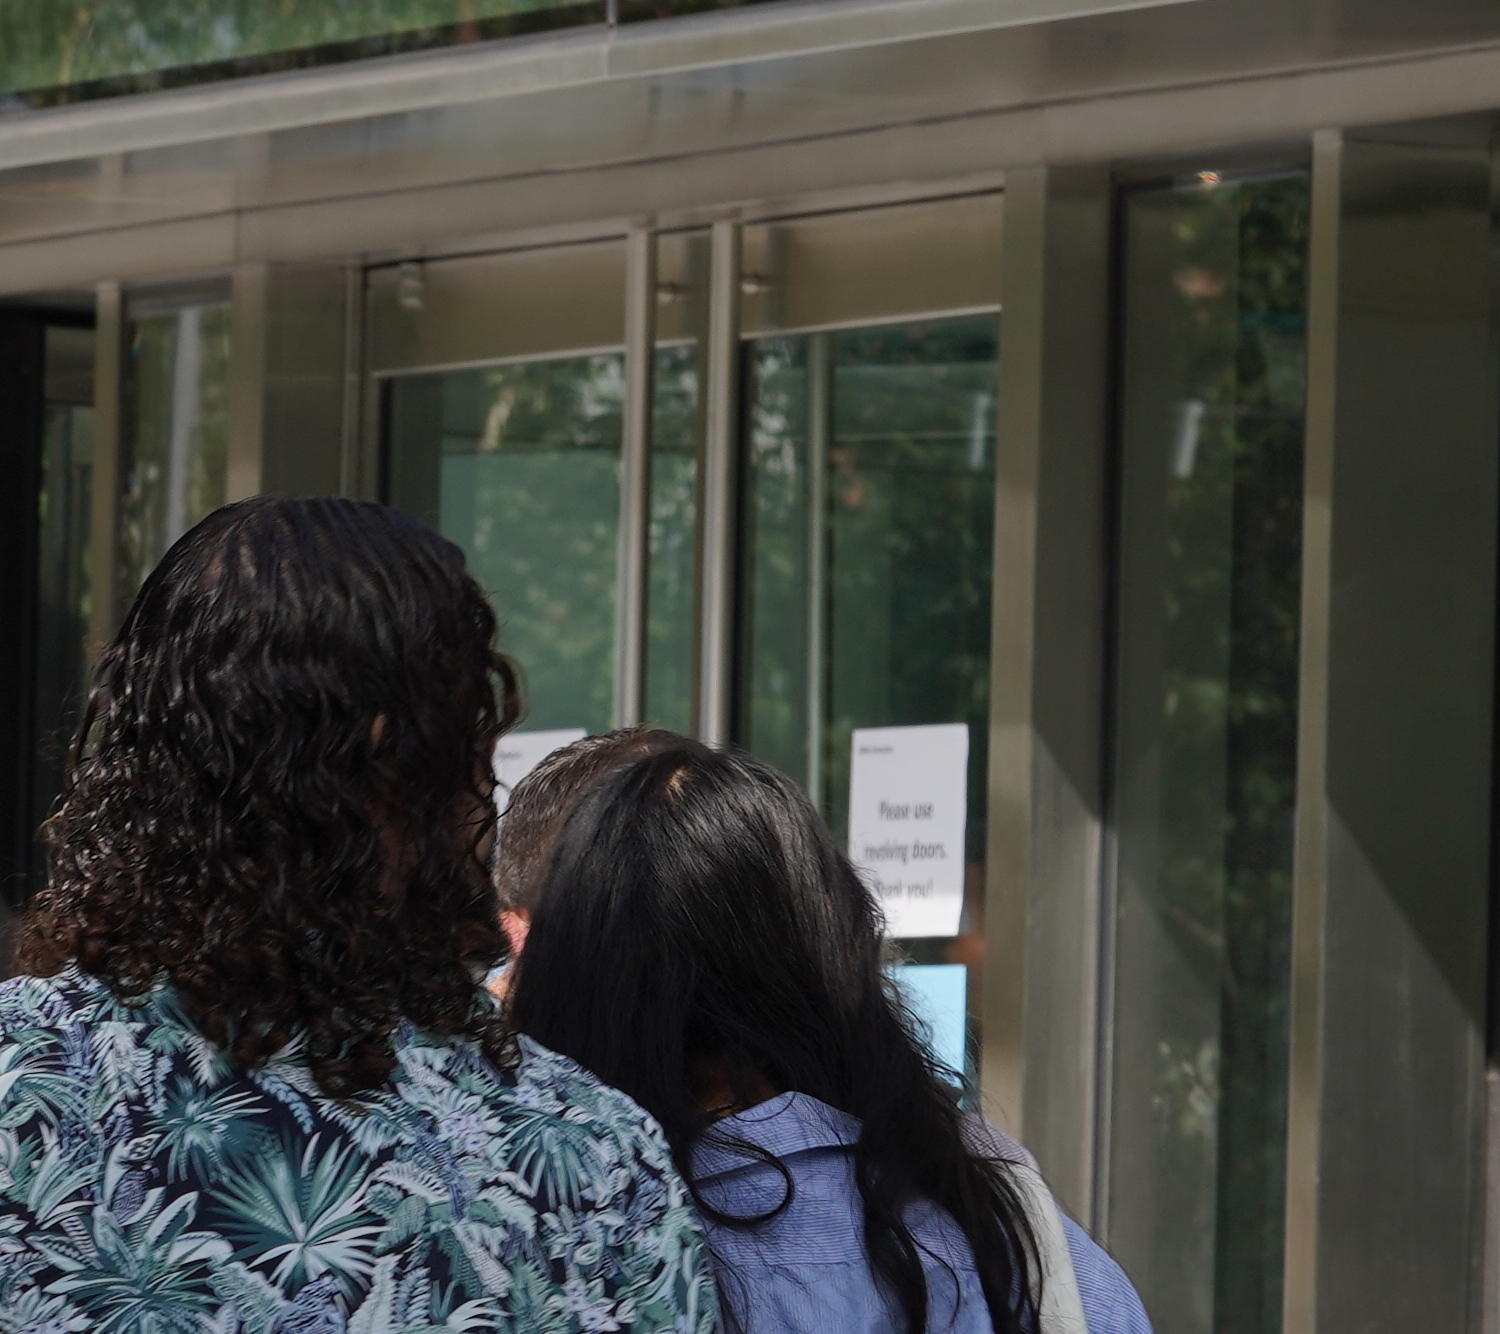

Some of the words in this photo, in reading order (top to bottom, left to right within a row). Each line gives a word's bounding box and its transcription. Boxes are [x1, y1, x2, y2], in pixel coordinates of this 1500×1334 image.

[880, 800, 911, 821] Please
[914, 803, 934, 819] use
[864, 839, 908, 865] revolving
